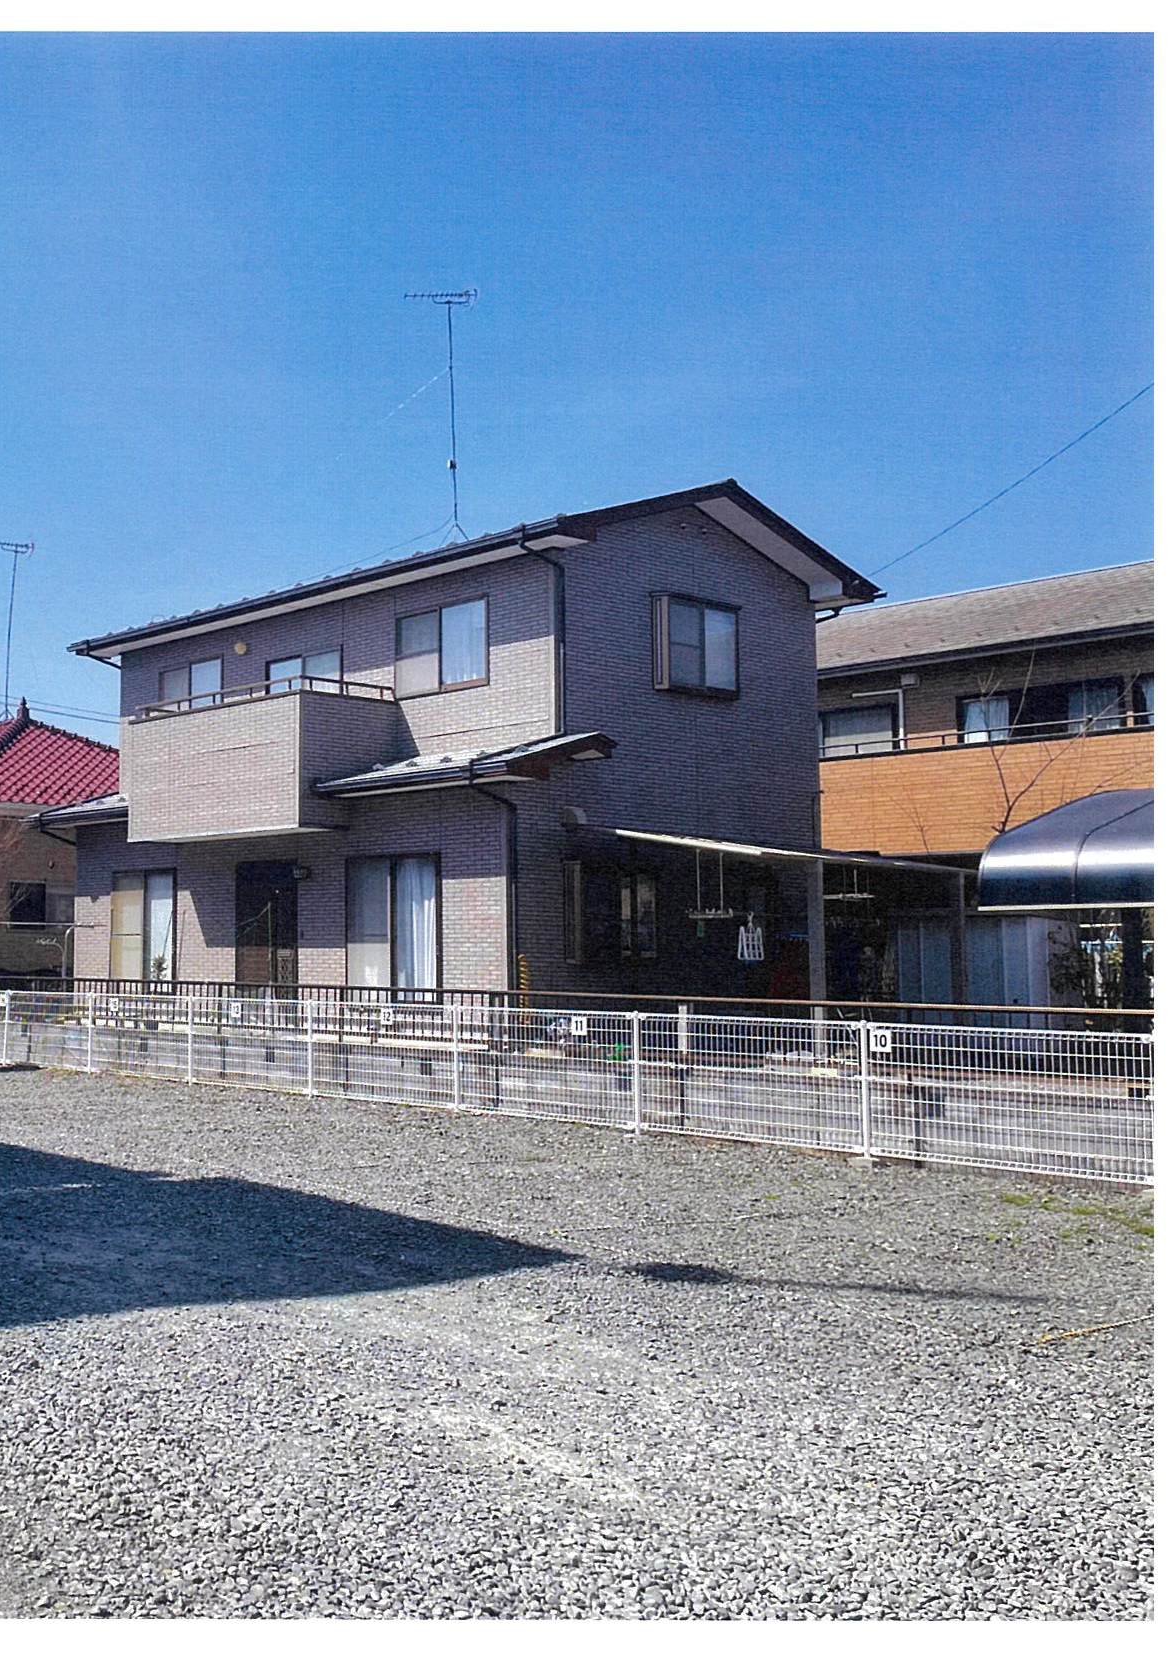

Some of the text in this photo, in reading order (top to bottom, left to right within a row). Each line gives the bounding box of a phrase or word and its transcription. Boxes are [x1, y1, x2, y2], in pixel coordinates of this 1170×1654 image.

[382, 1011, 391, 1022] 12
[574, 1020, 583, 1032] 11
[873, 1034, 887, 1048] 10
